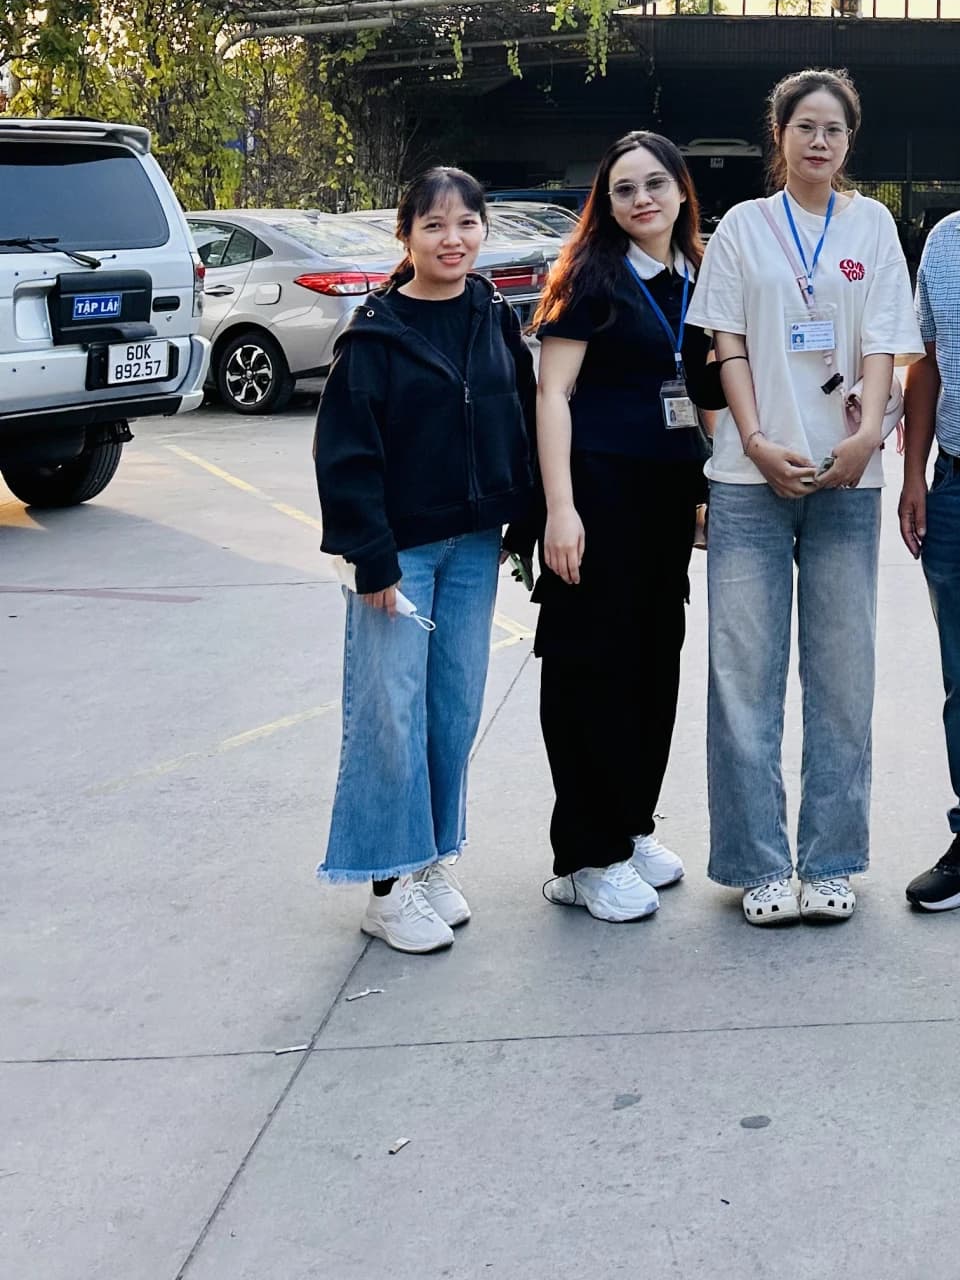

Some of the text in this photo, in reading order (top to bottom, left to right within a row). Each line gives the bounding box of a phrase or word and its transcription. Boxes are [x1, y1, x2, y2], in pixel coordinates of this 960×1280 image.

[839, 259, 865, 272] LOVE
[841, 269, 865, 282] YOU
[76, 299, 118, 315] TẬP LÁI
[126, 343, 151, 361] 60K
[115, 360, 161, 380] 892.57
